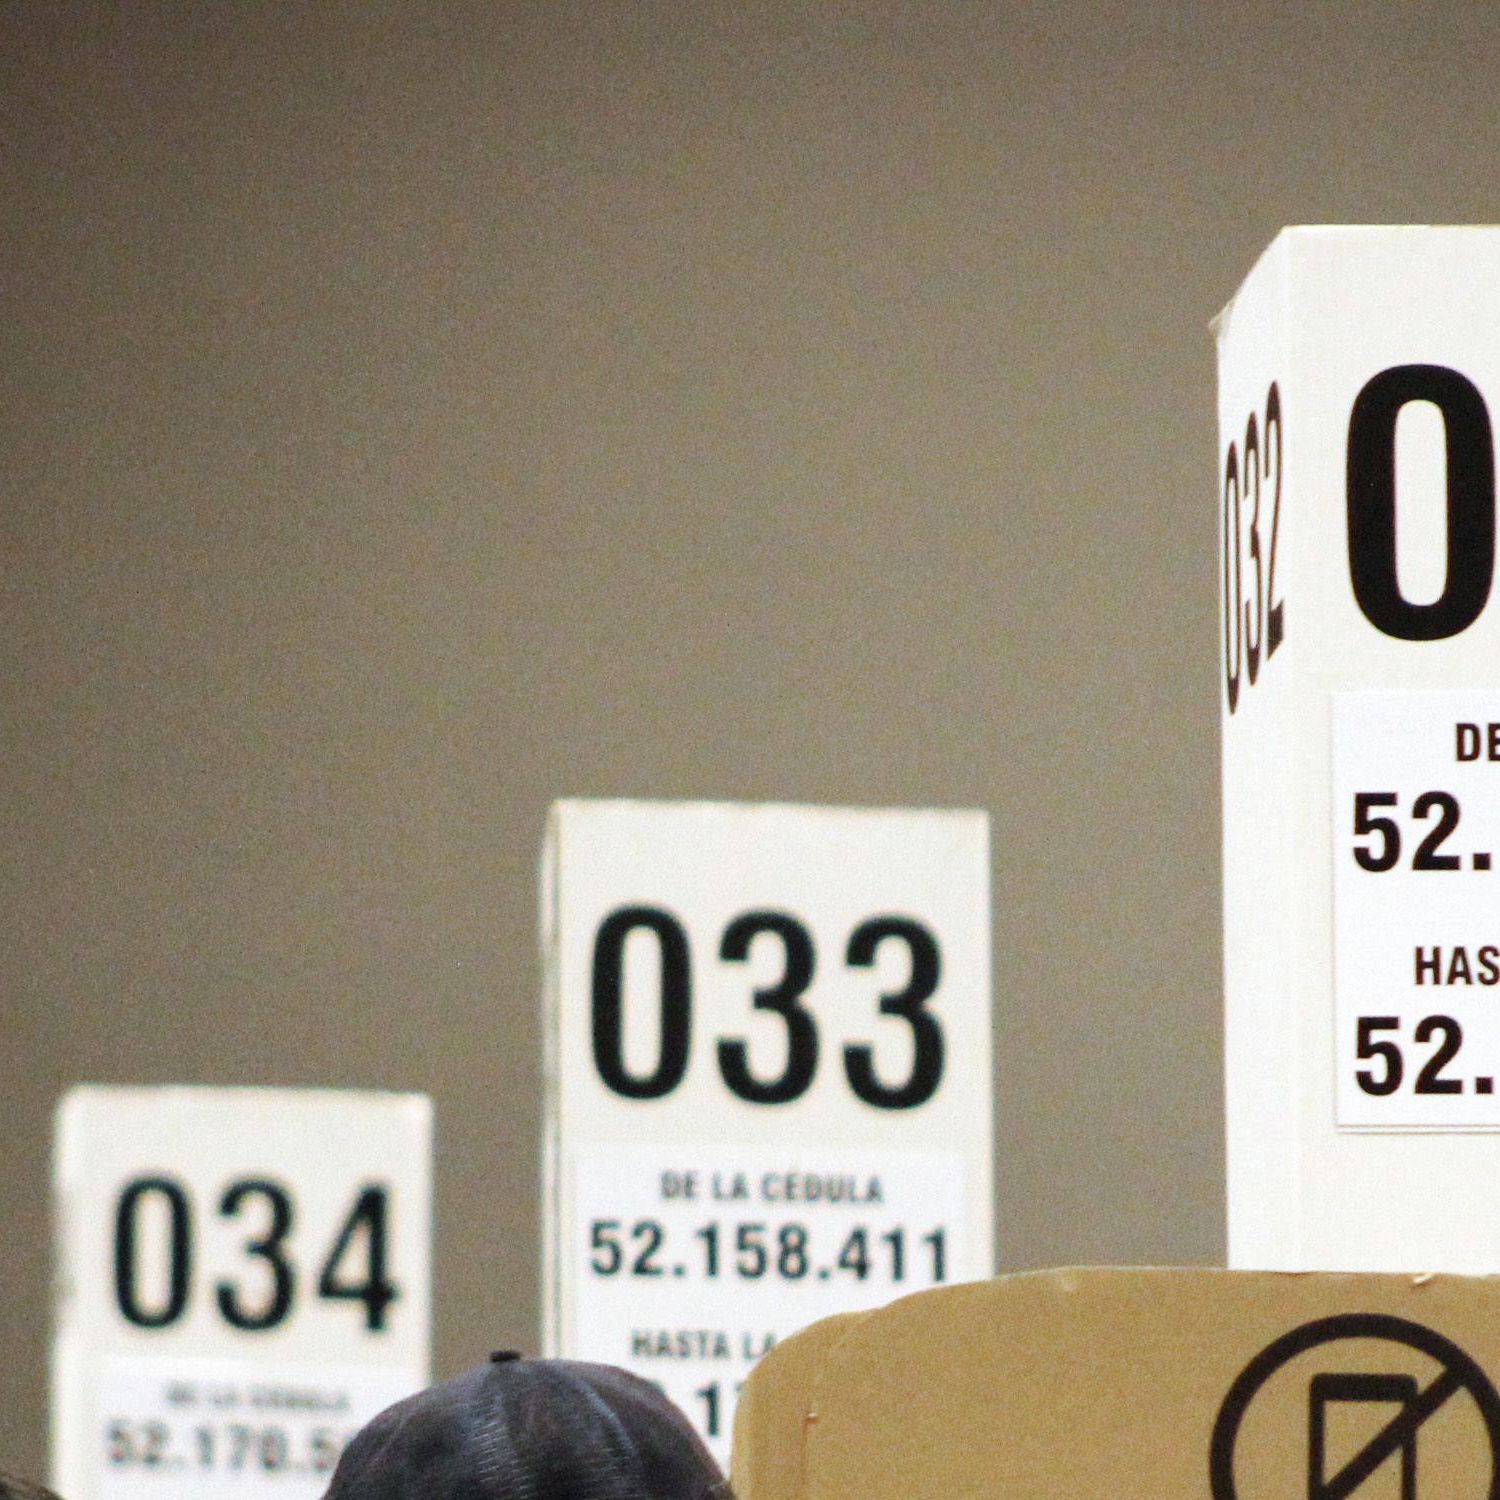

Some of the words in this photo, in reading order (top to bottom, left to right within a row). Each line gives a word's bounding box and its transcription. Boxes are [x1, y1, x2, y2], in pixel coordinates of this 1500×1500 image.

[1223, 381, 1284, 716] 032
[590, 904, 945, 1110] 033
[660, 1171, 698, 1202] DE
[711, 1173, 749, 1202] LA
[111, 1174, 399, 1333] 034
[590, 1220, 950, 1283] 52.158.411
[631, 1331, 730, 1360] HASTA
